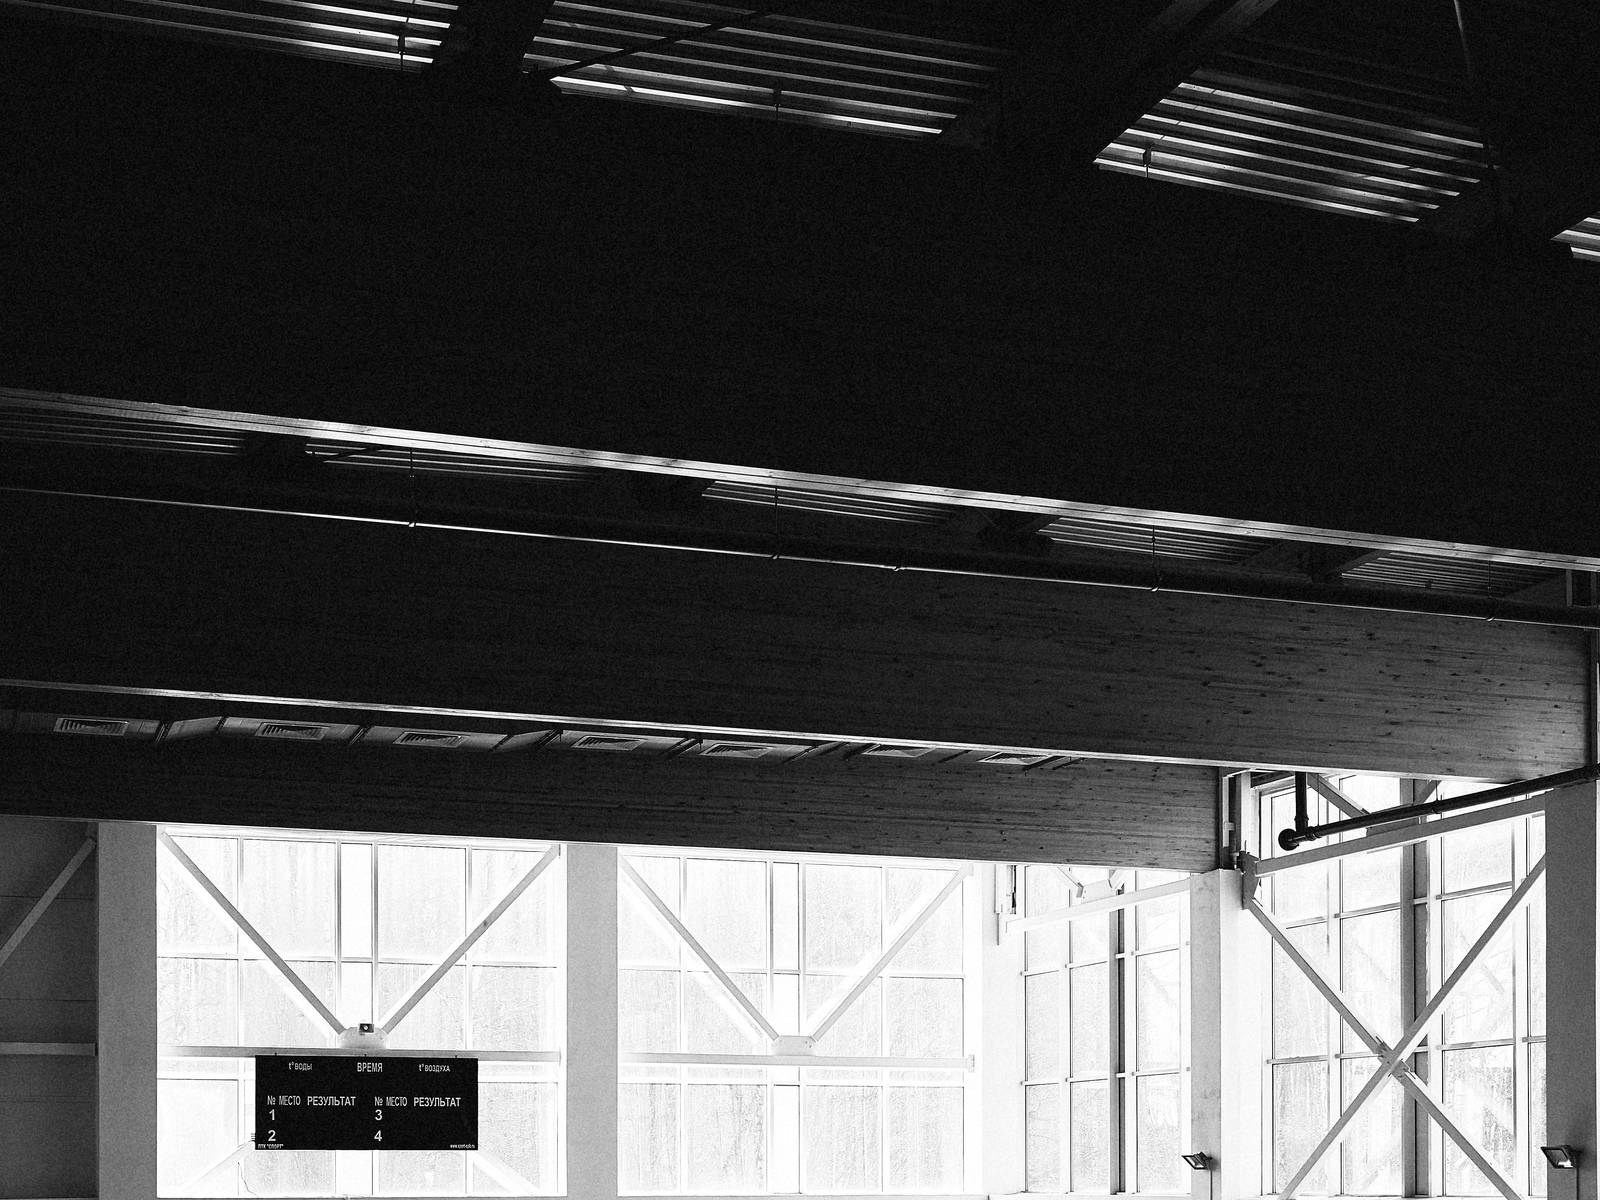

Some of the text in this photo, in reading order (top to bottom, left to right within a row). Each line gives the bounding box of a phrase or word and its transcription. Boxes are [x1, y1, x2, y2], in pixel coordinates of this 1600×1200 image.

[356, 1062, 383, 1072] ВРЕМЯ
[267, 1095, 356, 1106] № МЕСТО РЕЗУЛЬТАТ
[374, 1096, 461, 1107] № МЕСТО РЕЗУЛЬТАТ
[268, 1109, 275, 1120] 1
[374, 1109, 383, 1120] 3
[267, 1129, 276, 1141] 2
[373, 1129, 383, 1141] 4
